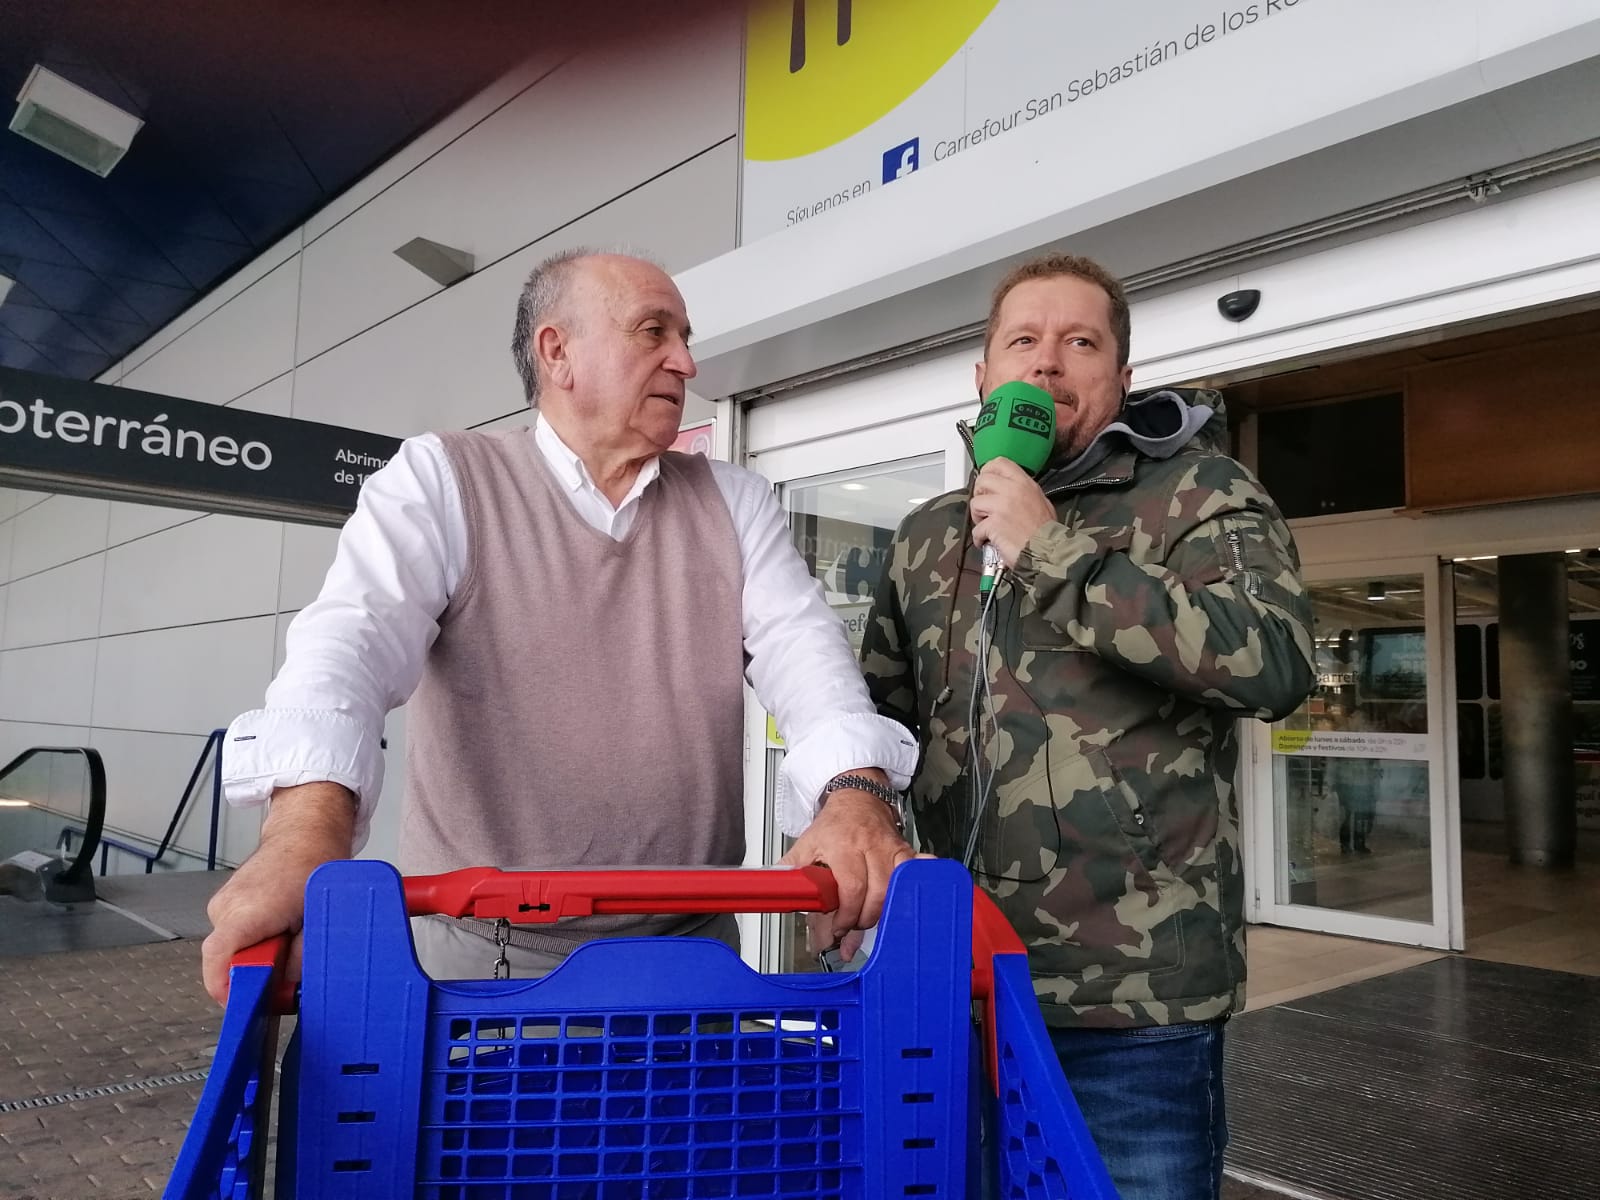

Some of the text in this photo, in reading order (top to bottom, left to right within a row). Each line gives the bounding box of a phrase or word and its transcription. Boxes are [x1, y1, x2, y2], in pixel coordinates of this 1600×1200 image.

[852, 179, 871, 198] en
[934, 110, 1022, 162] Carrefour
[1025, 98, 1062, 121] San
[1067, 41, 1177, 102] Sebastián
[1184, 24, 1215, 50] de
[1222, 5, 1259, 35] los
[1018, 416, 1047, 432] CERO
[334, 469, 355, 485] de
